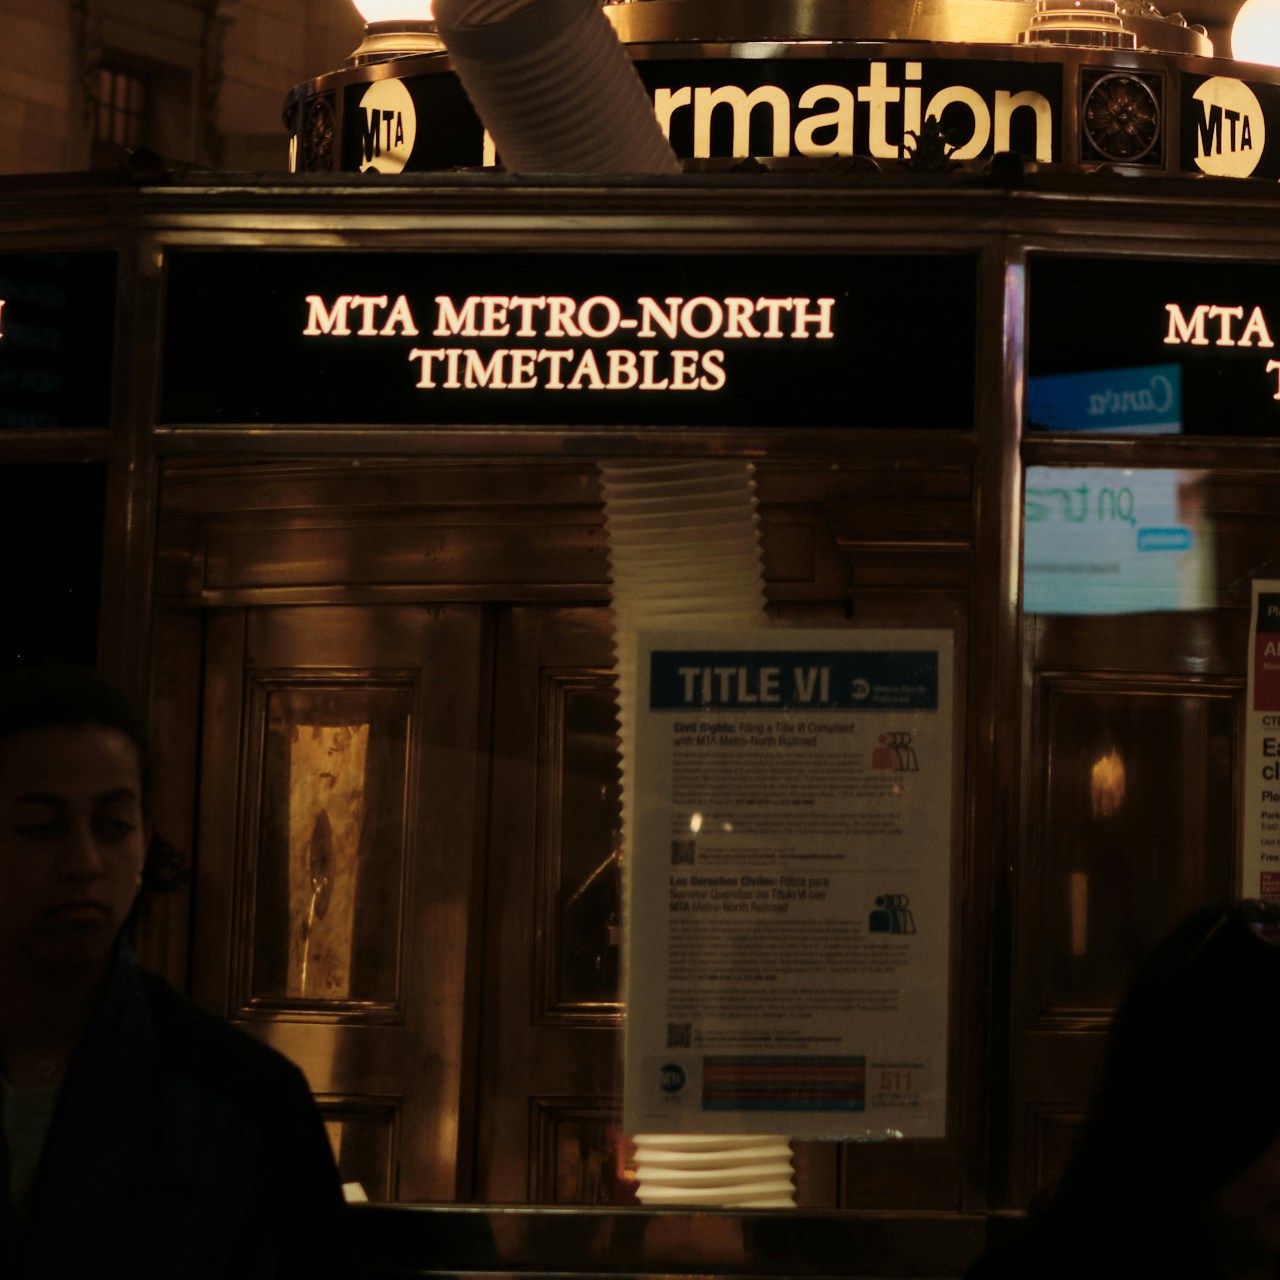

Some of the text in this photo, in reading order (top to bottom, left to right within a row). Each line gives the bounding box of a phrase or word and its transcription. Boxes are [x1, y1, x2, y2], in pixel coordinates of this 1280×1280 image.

[303, 295, 835, 339] MTA METRO-NORTH
[1164, 304, 1274, 348] MTA
[409, 348, 726, 390] TIMETABLES
[678, 666, 831, 703] TITLE VI
